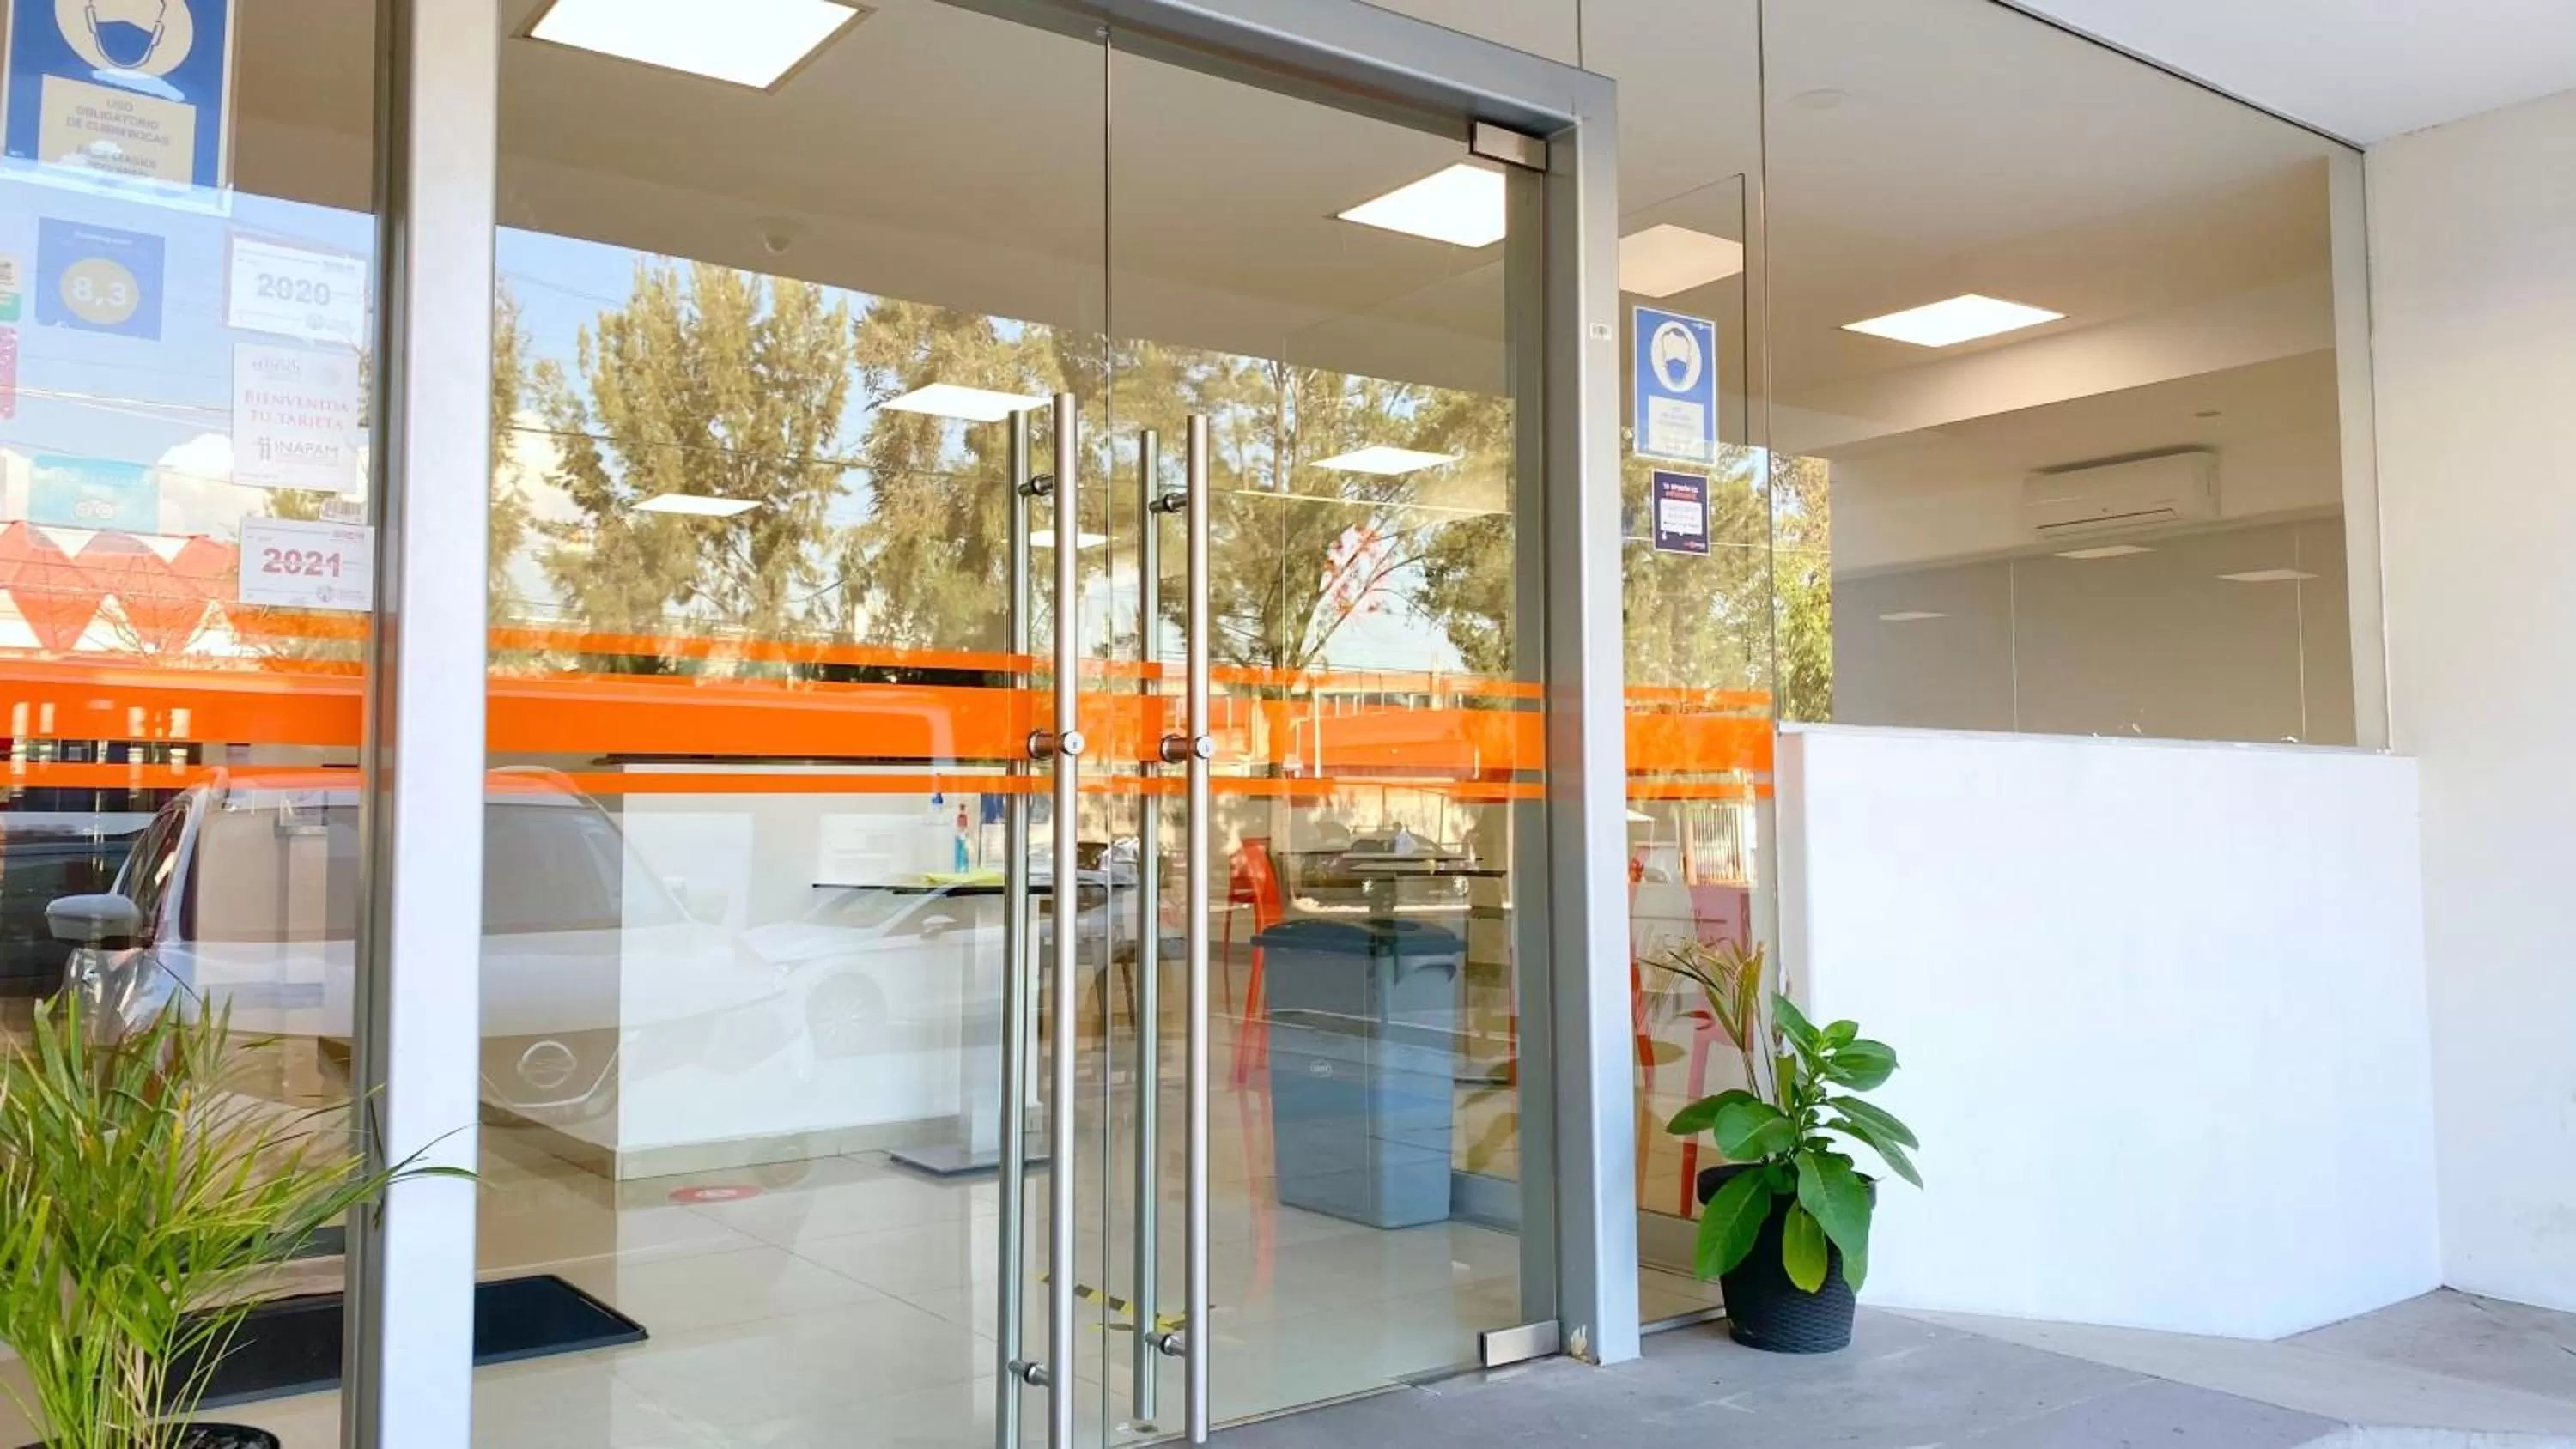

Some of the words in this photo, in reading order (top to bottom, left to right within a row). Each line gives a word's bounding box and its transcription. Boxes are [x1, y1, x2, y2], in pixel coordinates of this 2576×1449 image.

[71, 276, 128, 307] 8,3
[258, 272, 331, 306] 2020
[244, 389, 349, 413] BIENVENIDA
[251, 409, 273, 423] TU
[276, 413, 343, 432] TARJETA
[261, 547, 342, 579] 2021
